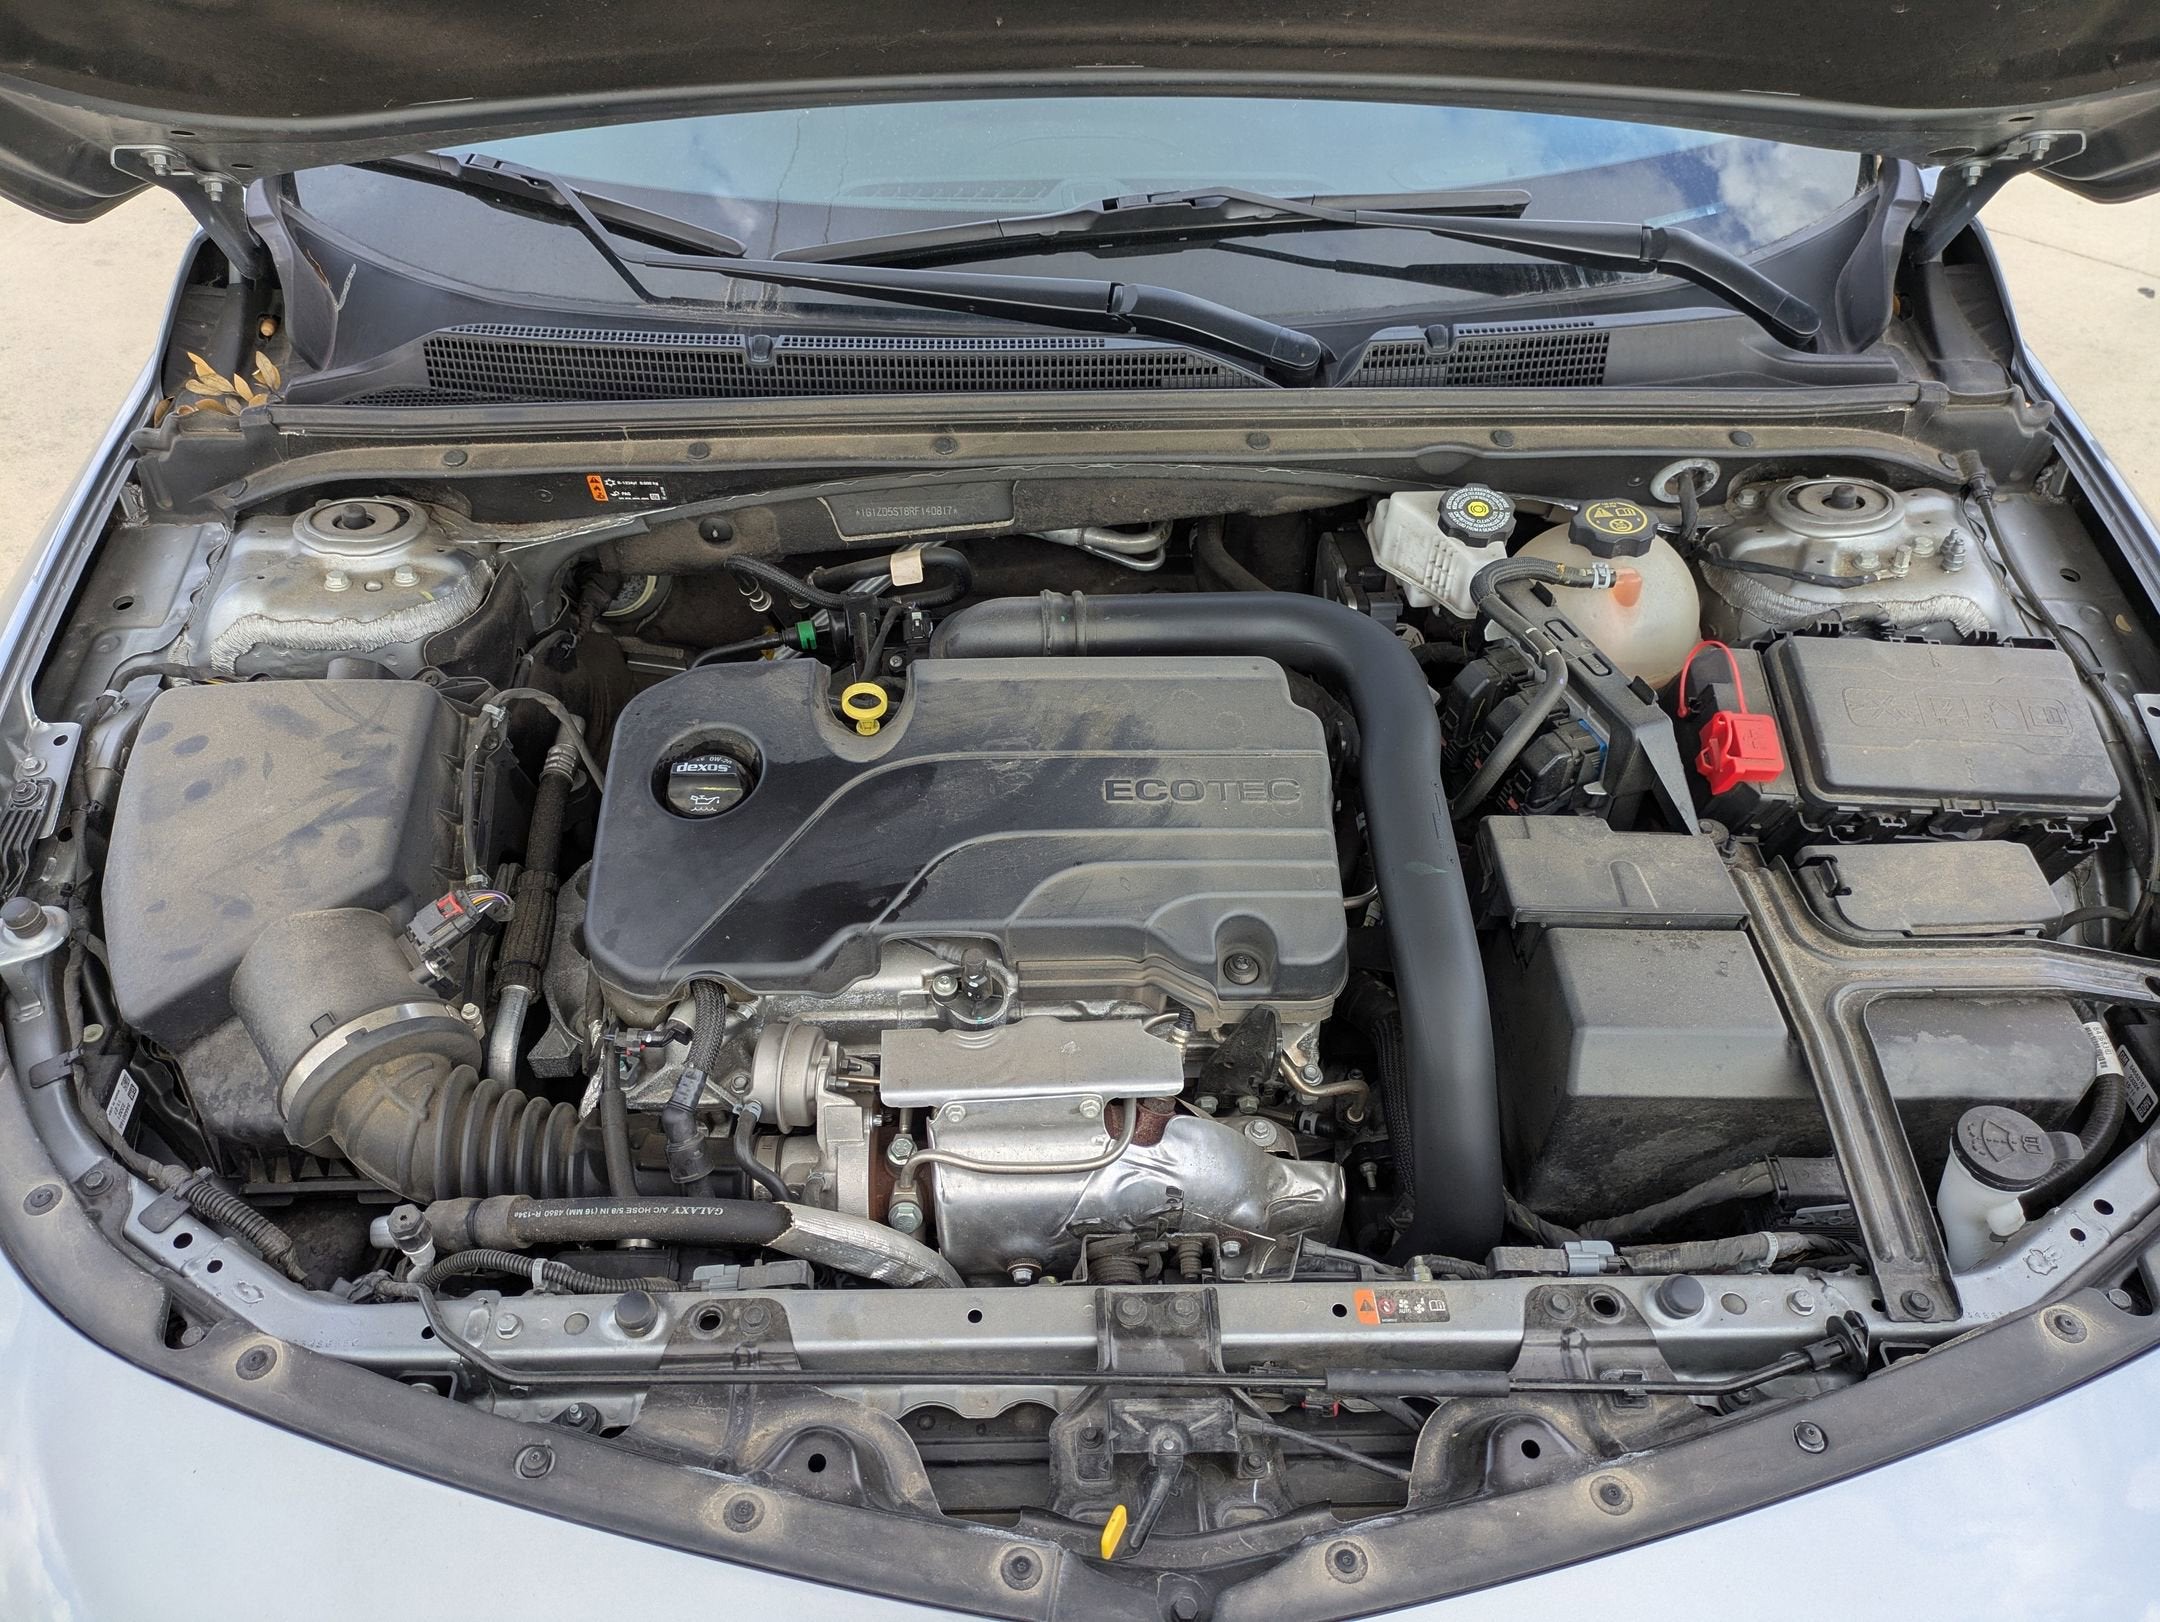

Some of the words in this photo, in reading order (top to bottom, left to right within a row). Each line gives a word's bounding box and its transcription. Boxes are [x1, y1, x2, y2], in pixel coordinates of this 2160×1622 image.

[676, 762, 729, 772] dexos
[1103, 778, 1301, 803] ECOTEC
[566, 1208, 584, 1216] MM)
[599, 1207, 609, 1215] IN
[626, 1206, 651, 1214] HOSE
[671, 1206, 724, 1216] GALAXY
